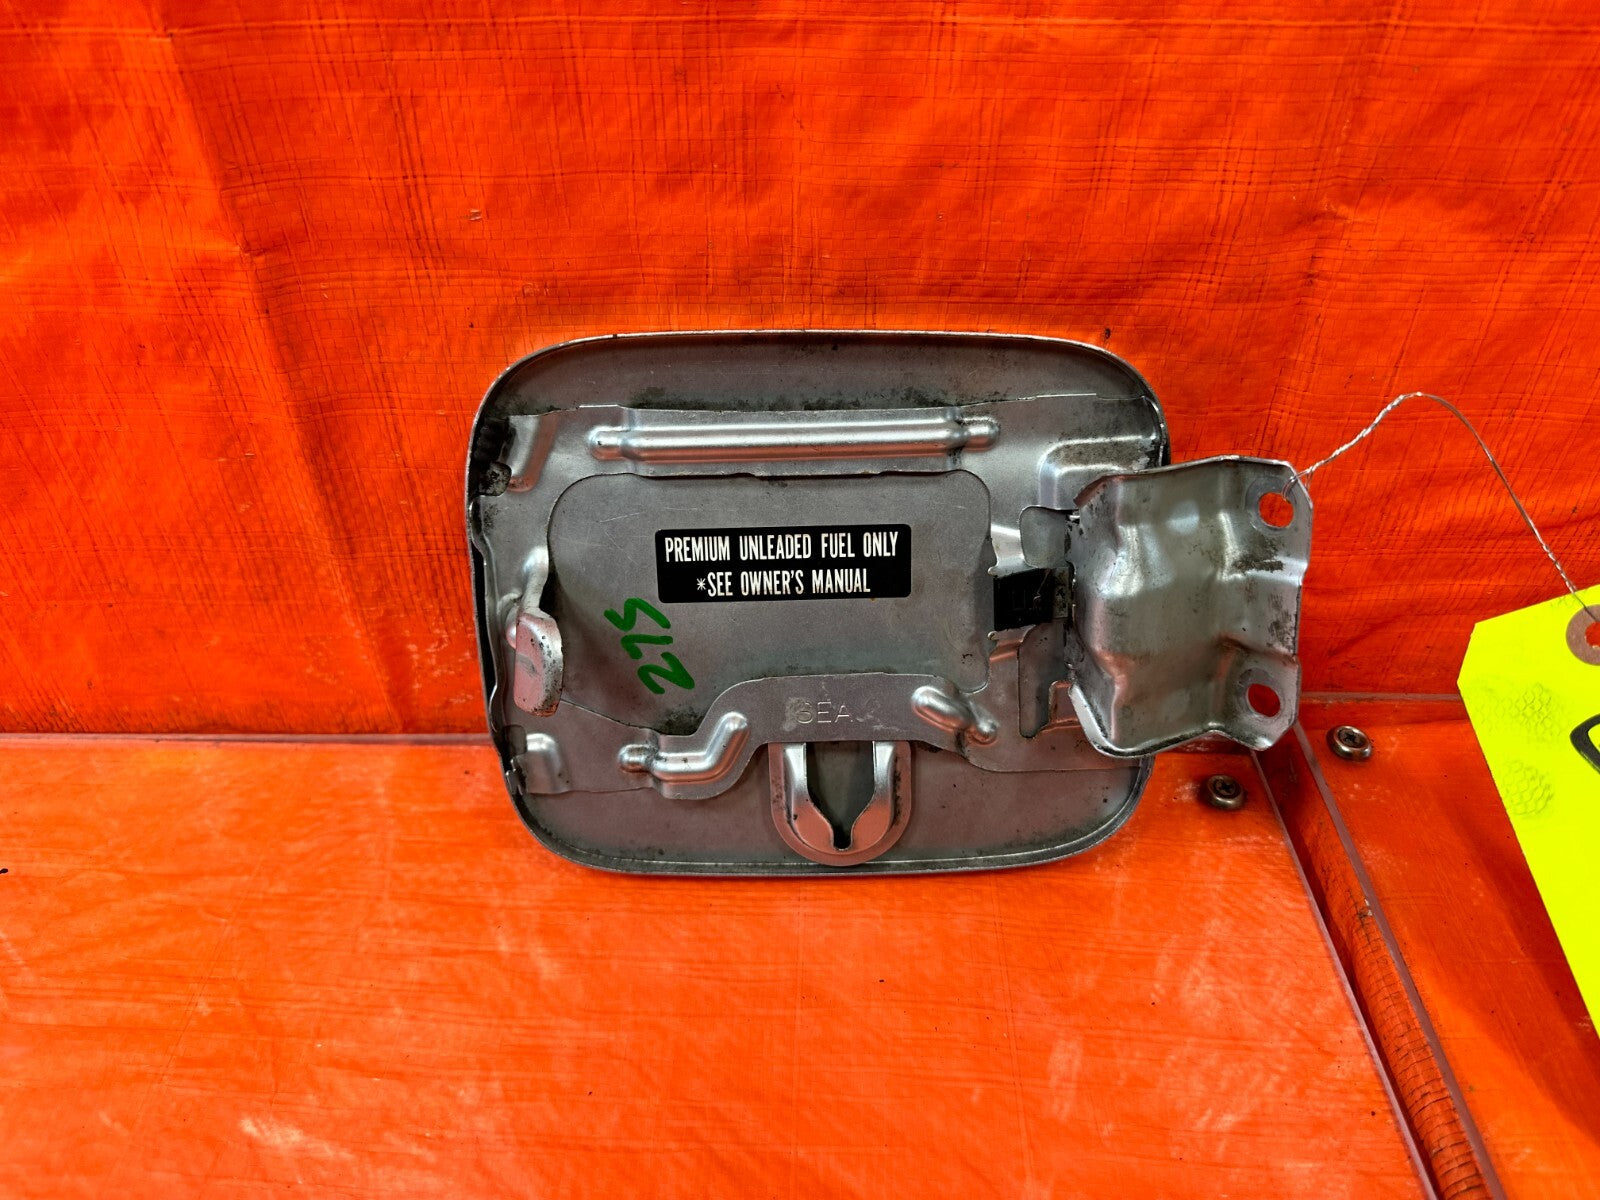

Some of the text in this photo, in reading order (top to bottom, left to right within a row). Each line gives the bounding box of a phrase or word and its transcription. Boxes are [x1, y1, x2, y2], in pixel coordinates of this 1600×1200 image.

[664, 531, 899, 562] PREMIUM UNLEADED FUEL ONLY
[740, 569, 804, 596] OWNER'S
[811, 567, 871, 594] MANUAL
